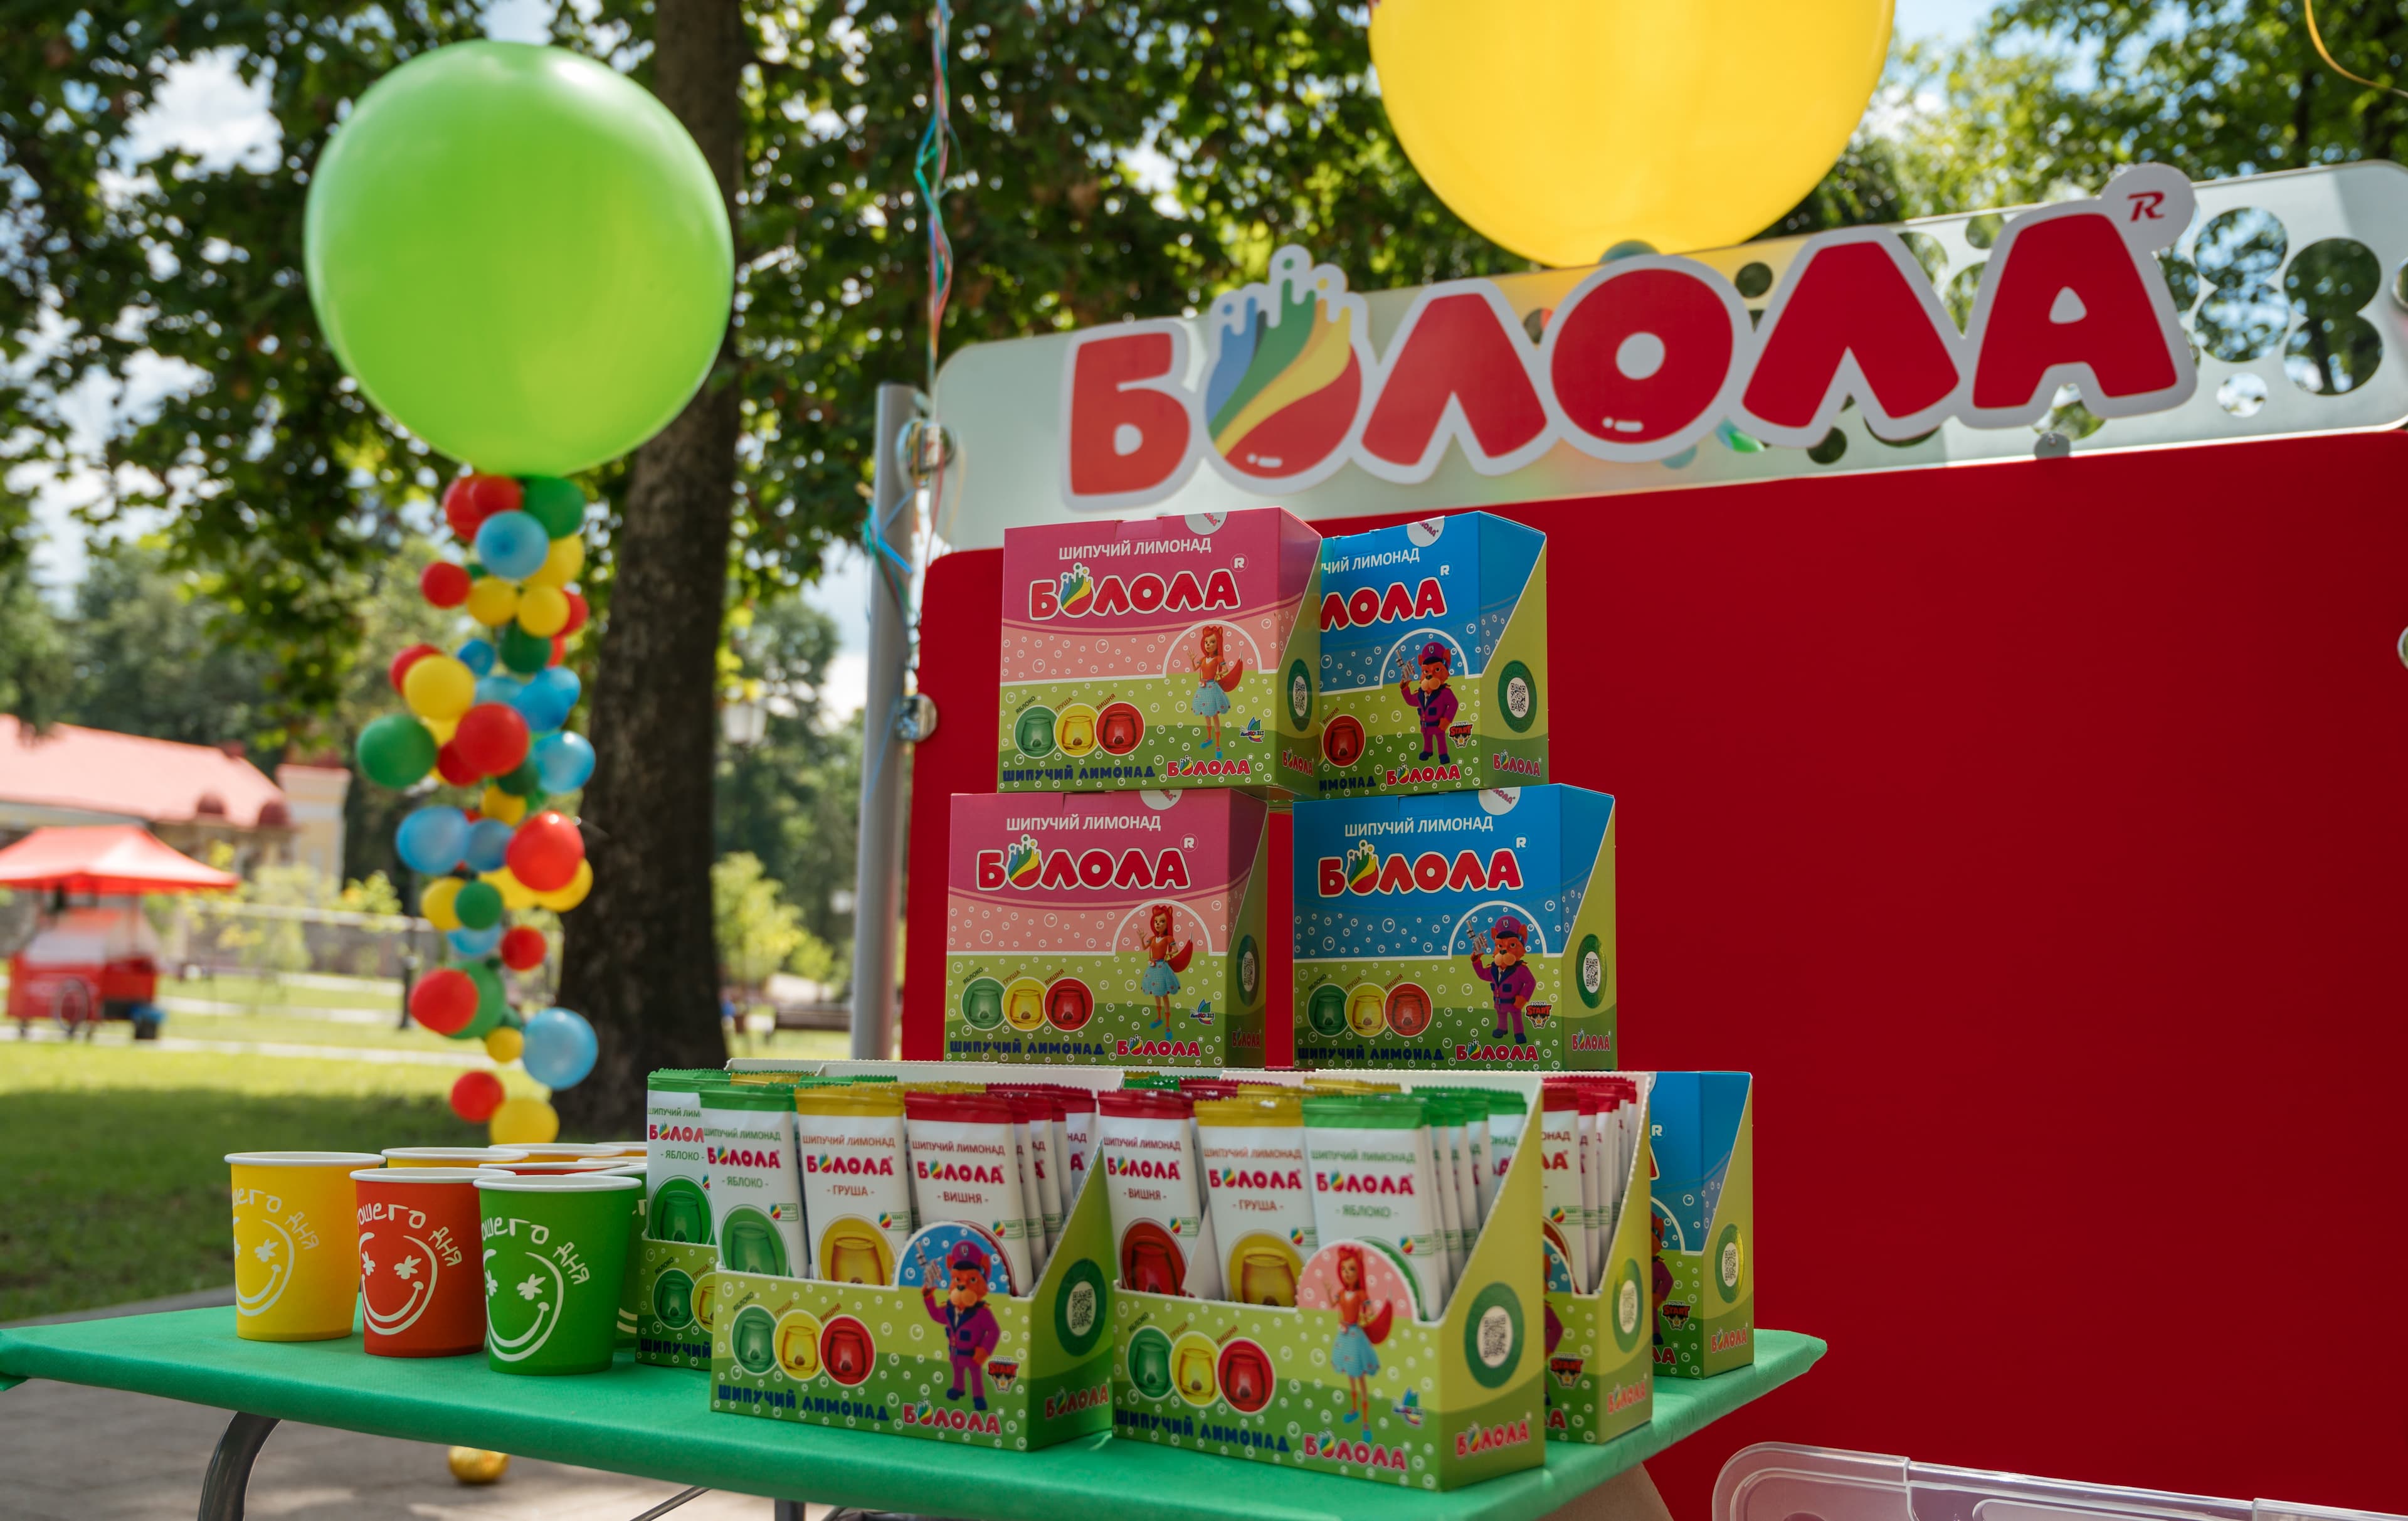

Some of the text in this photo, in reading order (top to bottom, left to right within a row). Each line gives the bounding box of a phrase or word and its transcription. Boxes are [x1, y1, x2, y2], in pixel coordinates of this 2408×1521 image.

[1065, 207, 2185, 502] БОЛОЛА
[1059, 538, 1212, 560] ШИПУЧИЙ ЛИМОНАД
[1352, 548, 1420, 571] ЛИМОНАД
[1028, 563, 1241, 621] БОЛОЛА
[1321, 576, 1447, 633] ЛОЛА
[1015, 696, 1037, 714] ЯБЛОКО
[1055, 696, 1074, 713] ГРУША
[1096, 693, 1116, 711] ВИШНЯ
[1323, 707, 1340, 725] ВИШНЯ
[1449, 724, 1473, 739] START
[1167, 755, 1252, 778] БОЛОЛА
[1282, 748, 1314, 777] БОЛОЛА
[1492, 749, 1541, 778] БОЛОЛА
[1003, 765, 1156, 782] ШИПУЧИЙ ЛИМОНАД
[1386, 763, 1462, 787] БОЛОЛА
[1319, 776, 1376, 792] ИМОНАД
[1006, 813, 1161, 832] ШИПУЧИЙ ЛИМОНАД
[1344, 816, 1493, 837] ШИПУЧИЙ ЛИМОНАД
[977, 834, 1191, 891] БОЛОЛА
[1319, 839, 1524, 898] БОЛОЛА
[963, 967, 984, 985] ЯБЛОКО
[1003, 969, 1021, 985] ГРУША
[1044, 968, 1065, 985] ВИШНЯ
[1307, 973, 1328, 992] ЯБЛОКО
[1344, 975, 1362, 991] ГРУША
[1383, 973, 1404, 991] ВИШНЯ
[1525, 1005, 1552, 1019] START
[949, 1038, 1105, 1056] ШИПУЧИЙ ЛИМОНАД
[1116, 1034, 1201, 1057] БОЛОЛА
[1231, 1026, 1261, 1049] БОЛОЛА
[1571, 1029, 1611, 1052] БОЛОЛА
[1297, 1044, 1445, 1061] ШИПУЧИЙ ЛИМОНАД
[1455, 1039, 1539, 1062] БОЛОЛА
[648, 1107, 682, 1117] ШИПУЧИЙ
[649, 1120, 705, 1143] БОЛОЛ
[704, 1127, 781, 1142] ШИПУЧИЙ ЛИМОНАД
[803, 1135, 896, 1148] ШИПУЧИЙ ЛИМОНАД
[912, 1140, 955, 1152] ШИПУЧИЙ
[956, 1142, 1006, 1156] ЛИМОНАД
[1104, 1137, 1181, 1152] ШИПУЧИЙ ЛИМОНАД
[1203, 1147, 1302, 1160] ШИПУЧИЙ ЛИМОНАД
[665, 1150, 699, 1161] ЯБЛОКО
[707, 1143, 781, 1169] БОЛОЛА
[806, 1152, 894, 1176] БОЛОЛА
[917, 1159, 1005, 1184] БОЛОЛА
[1107, 1154, 1181, 1180] БОЛОЛА
[727, 1176, 763, 1188] ЯБЛОКО
[1208, 1165, 1302, 1190] БОЛОЛА
[1316, 1170, 1415, 1195] БОЛОЛА
[833, 1184, 869, 1196] ГРУША
[943, 1191, 983, 1204] ВИШНЯ
[1128, 1188, 1161, 1200] ВИШНЯ
[1238, 1199, 1278, 1211] ГРУША
[1343, 1204, 1392, 1218] ЯБЛОКО
[655, 1256, 674, 1276] ЯБЛОКО
[692, 1263, 710, 1280] ГРУША
[733, 1291, 755, 1313] ЯБЛОКО
[1662, 1305, 1691, 1319] START
[820, 1302, 842, 1323] ВИШНЯ
[640, 1338, 711, 1359] ШИПУЧИЙ
[1710, 1327, 1748, 1354] БОЛОЛА
[718, 1384, 890, 1422] ШИПУЧИЙ ЛИМОНАД
[1045, 1384, 1109, 1420] БОЛОЛА
[903, 1399, 1002, 1436] БОЛОЛА
[1115, 1409, 1291, 1453] ШИПУЧИЙ ЛИМОНАД
[1455, 1420, 1530, 1458] БОЛОЛА
[1304, 1429, 1408, 1471] БОЛОЛА
